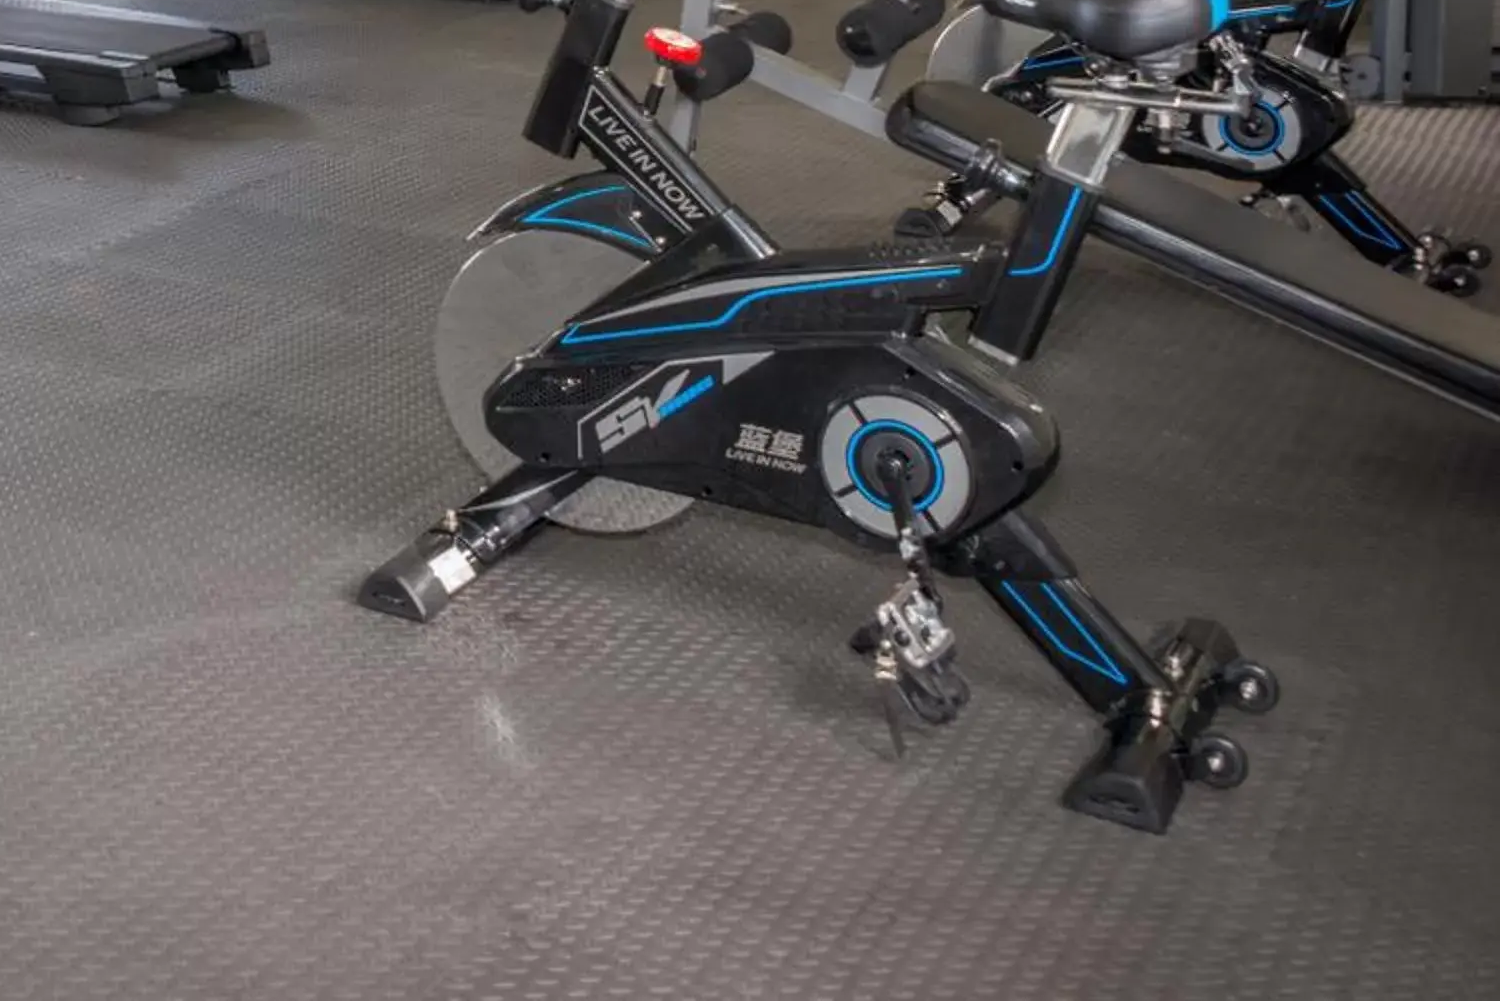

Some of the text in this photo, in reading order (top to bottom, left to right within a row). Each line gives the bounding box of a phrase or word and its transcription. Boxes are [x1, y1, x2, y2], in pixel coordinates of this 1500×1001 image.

[587, 106, 705, 219] LIVE IN NOW
[725, 447, 807, 474] LIVE IN NOW
